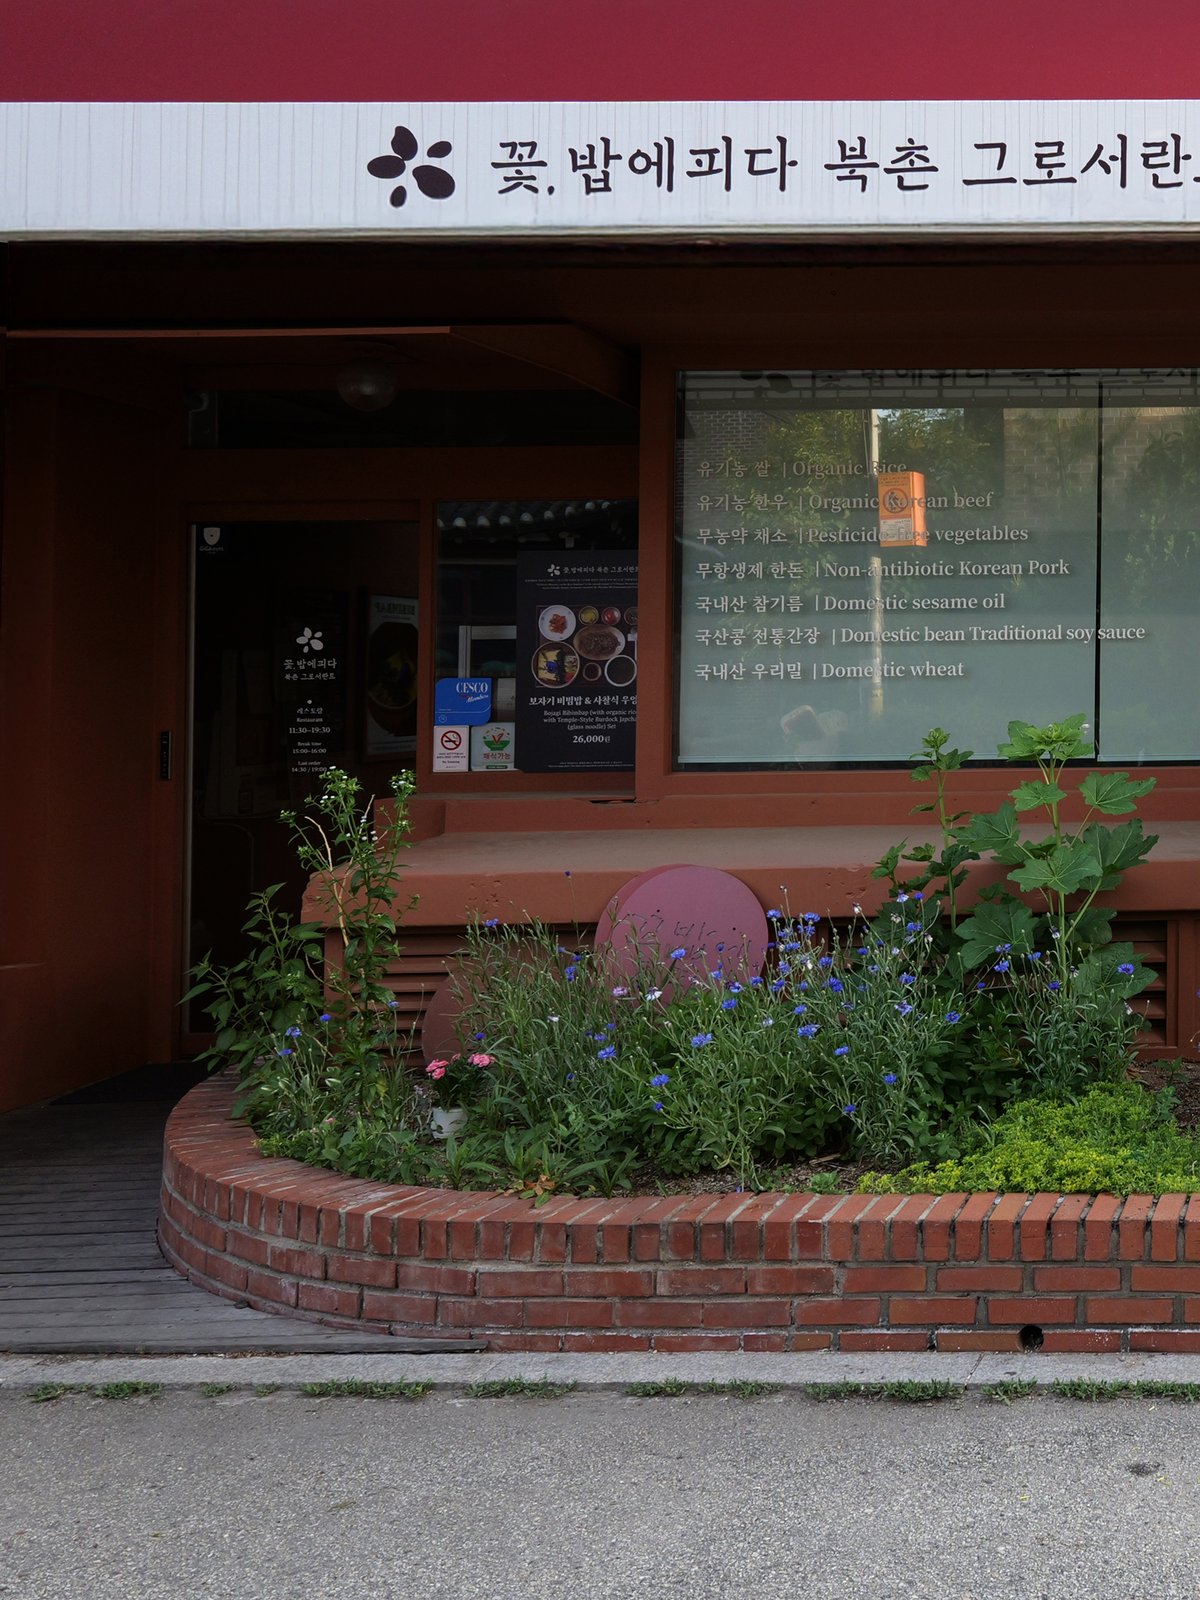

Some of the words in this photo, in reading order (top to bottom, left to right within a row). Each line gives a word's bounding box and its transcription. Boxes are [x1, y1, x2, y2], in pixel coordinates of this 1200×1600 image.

[823, 134, 940, 194] 북촌
[697, 460, 748, 478] 유기농
[754, 460, 771, 478] 쌀
[792, 460, 863, 479] Organic
[697, 494, 749, 512] 유기농
[754, 494, 788, 511] 한우
[809, 493, 879, 512] Organic
[954, 491, 994, 508] beef
[697, 528, 748, 545] 무농약
[753, 527, 787, 545] 채소
[935, 525, 1029, 545] vegetables
[696, 561, 763, 580] 무항생제
[769, 561, 804, 579] 한돈
[825, 560, 954, 577] Non-antibiotic
[959, 560, 1024, 576] Korean
[1028, 559, 1070, 575] Pork
[695, 595, 747, 613] 국내산
[752, 595, 804, 613] 참기름
[823, 594, 908, 611] Domestic
[912, 597, 978, 610] sesame
[982, 593, 1006, 609] oil
[695, 628, 746, 646] 국산콩
[752, 626, 820, 645] 전통간장
[841, 627, 920, 643] Domestic
[924, 626, 965, 642] bean
[969, 624, 1062, 641] Traditional
[1066, 628, 1095, 643] soy
[1097, 627, 1146, 640] sauce
[694, 662, 746, 681] 국내산
[751, 661, 802, 680] 우리밀
[821, 661, 905, 678] Domestic
[910, 661, 965, 677] wheat
[456, 682, 488, 693] CESCO
[529, 696, 555, 706] 보자기
[557, 695, 582, 706] 비빔밥
[584, 697, 592, 705] &
